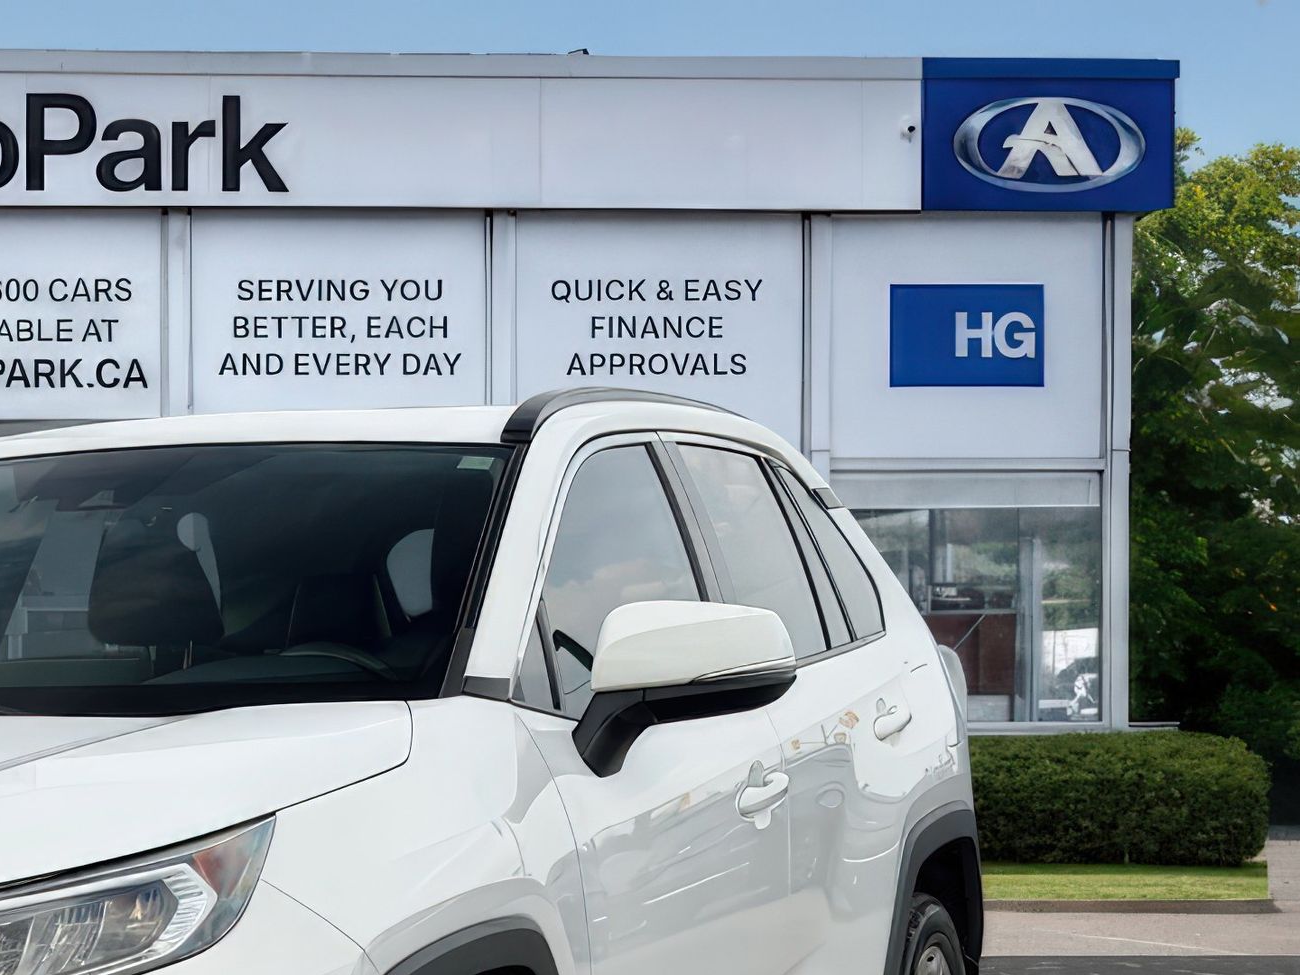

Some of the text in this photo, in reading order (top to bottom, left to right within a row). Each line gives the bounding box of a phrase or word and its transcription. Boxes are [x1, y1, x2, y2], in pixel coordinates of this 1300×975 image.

[48, 277, 132, 303] CARS
[237, 278, 443, 302] SERVING YOU
[551, 278, 763, 304] QUICK & EASY
[81, 318, 119, 343] AT
[233, 315, 448, 344] BETTER, EACH
[591, 315, 723, 340] FINANCE
[955, 311, 1036, 359] HG
[218, 352, 462, 376] AND EVERY DAY
[566, 352, 747, 376] APPROVALS
